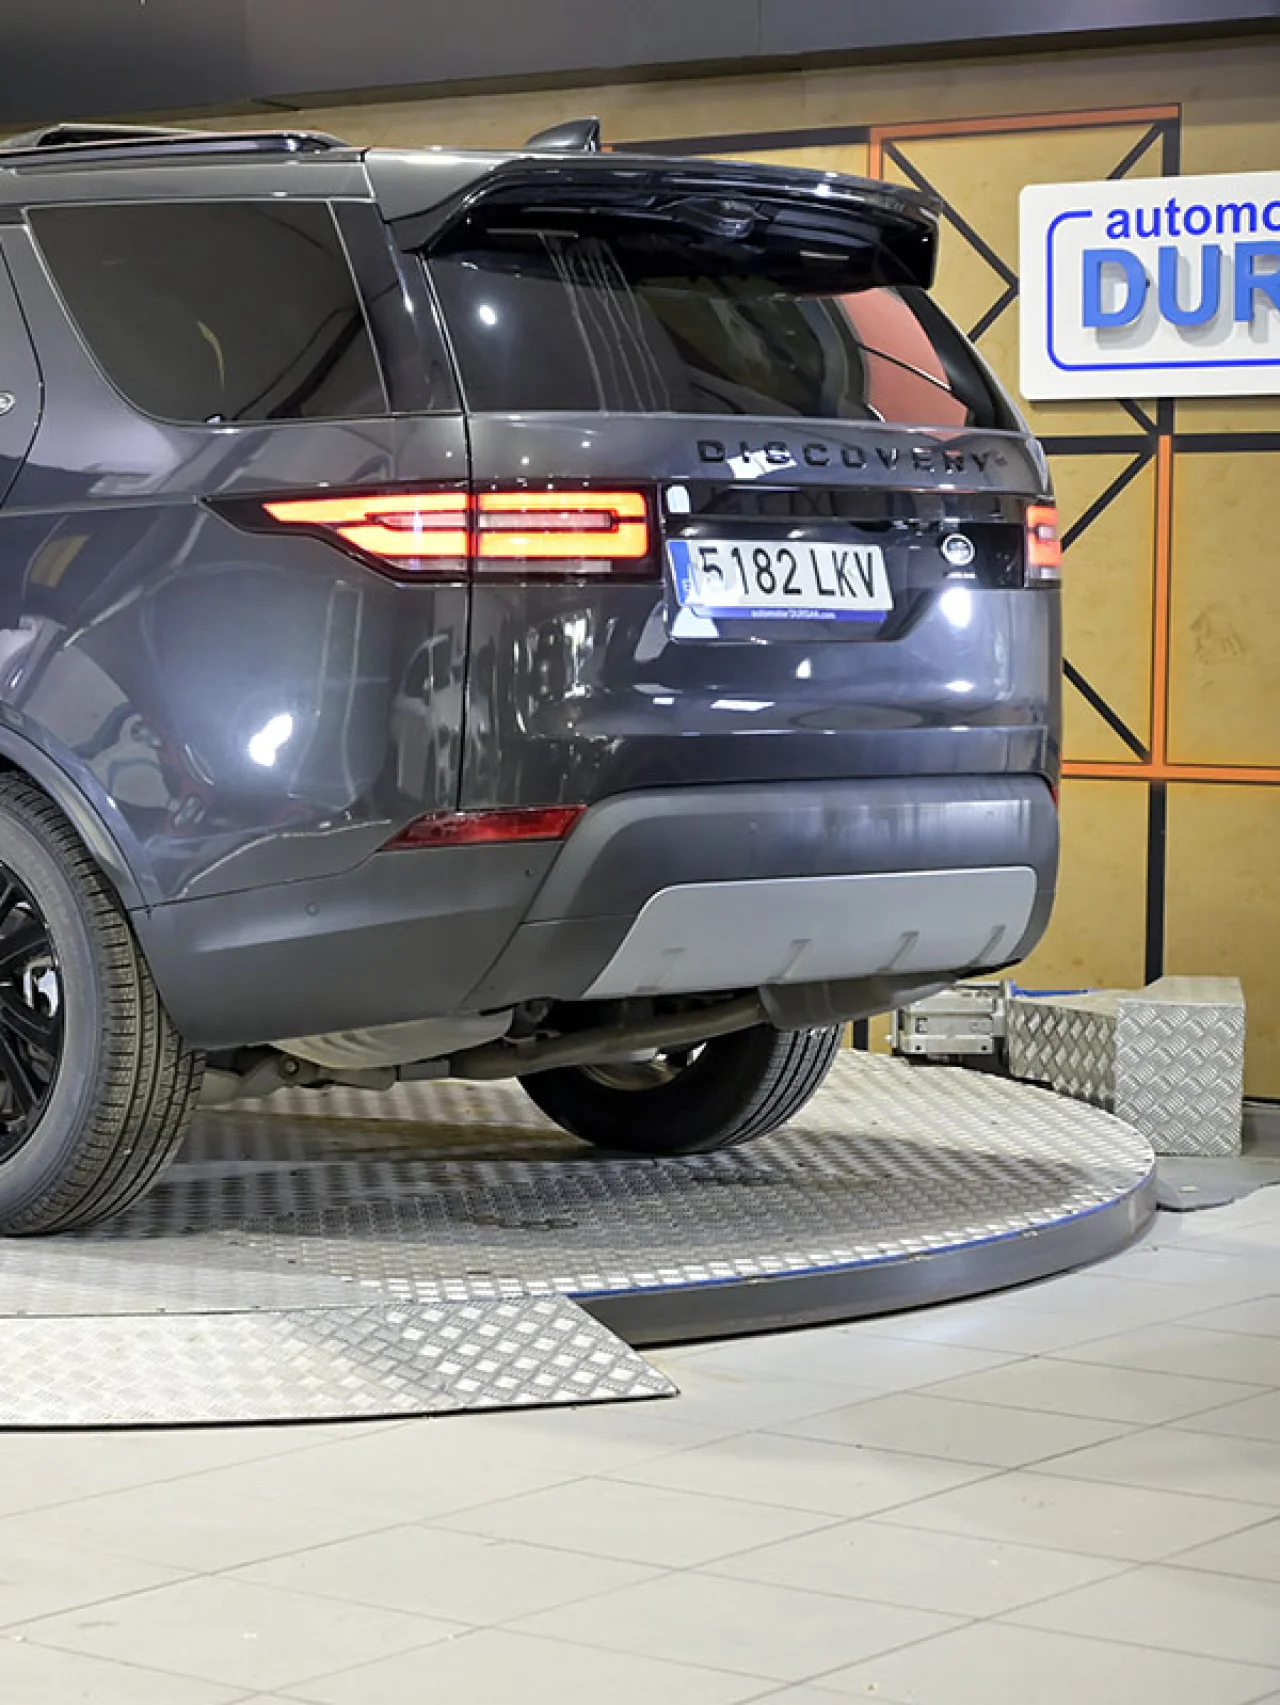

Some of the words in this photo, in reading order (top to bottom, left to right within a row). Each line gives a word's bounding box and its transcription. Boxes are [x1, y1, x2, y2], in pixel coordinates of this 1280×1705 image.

[697, 440, 990, 473] DISCOVERY
[699, 547, 802, 595] 5182
[810, 549, 875, 598] LKV
